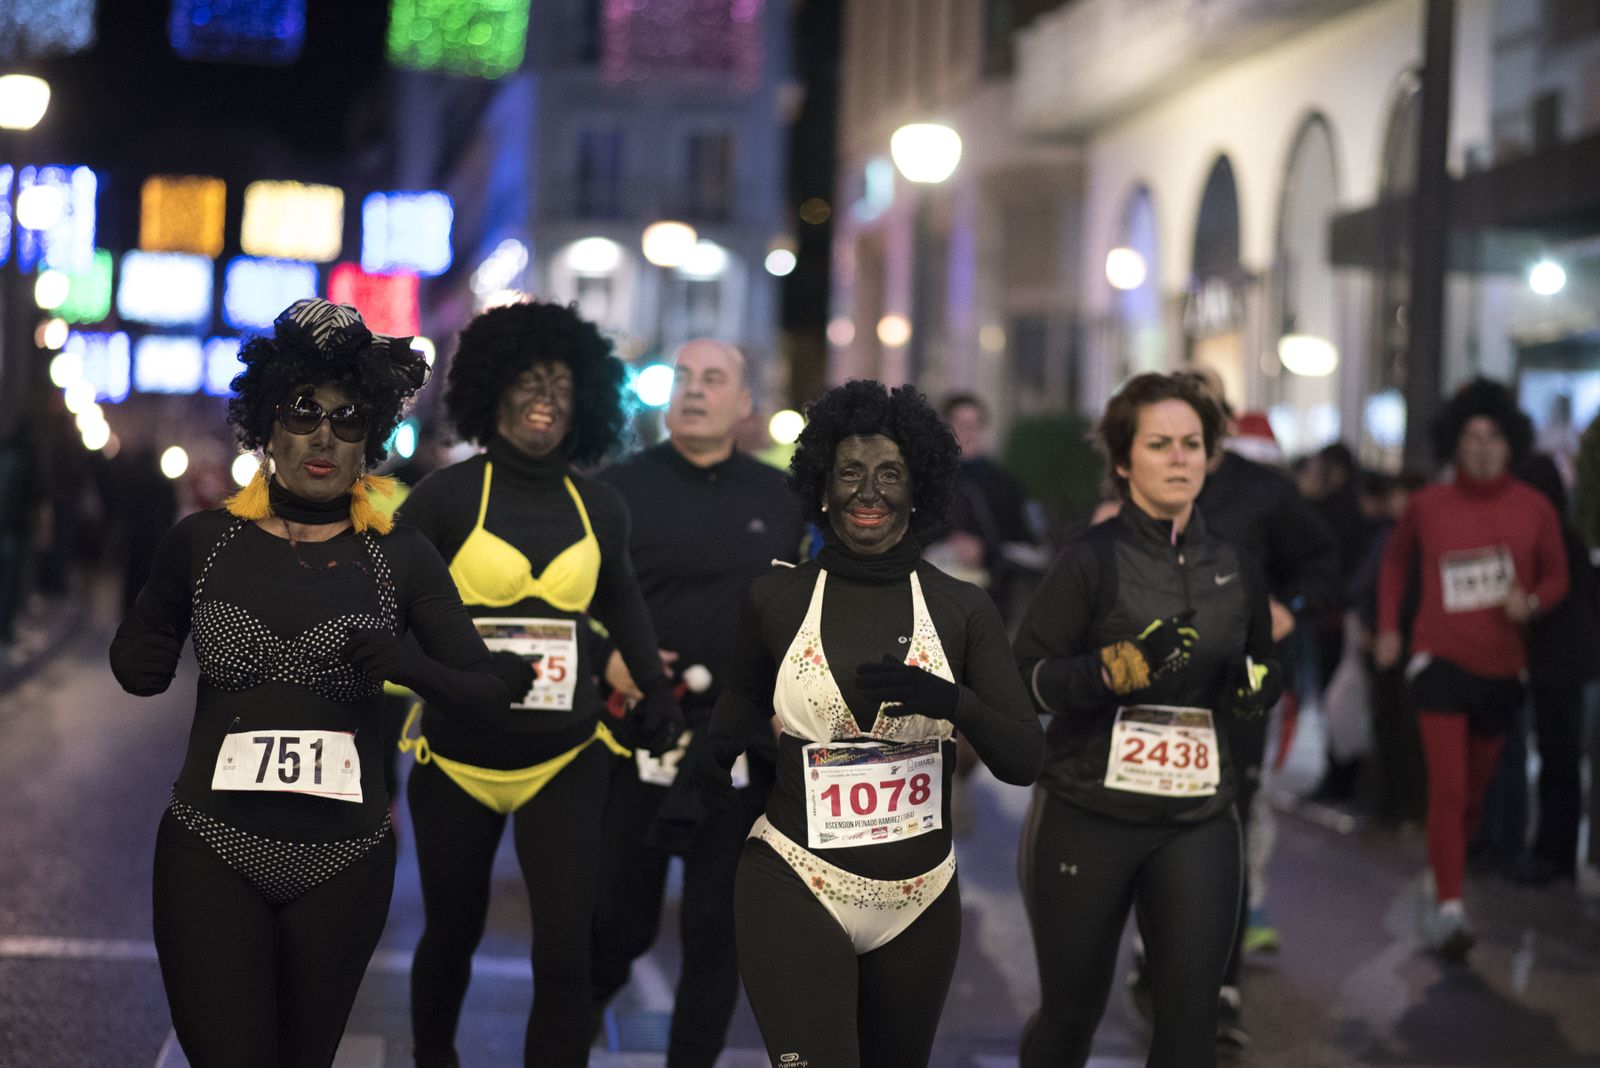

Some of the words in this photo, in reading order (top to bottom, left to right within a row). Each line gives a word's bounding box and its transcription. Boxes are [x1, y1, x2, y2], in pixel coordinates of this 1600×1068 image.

[252, 736, 324, 784] 751
[1120, 737, 1210, 770] 2438
[820, 772, 932, 817] 1078
[824, 819, 855, 830] ASCENSION
[878, 814, 901, 826] RAMIREZ
